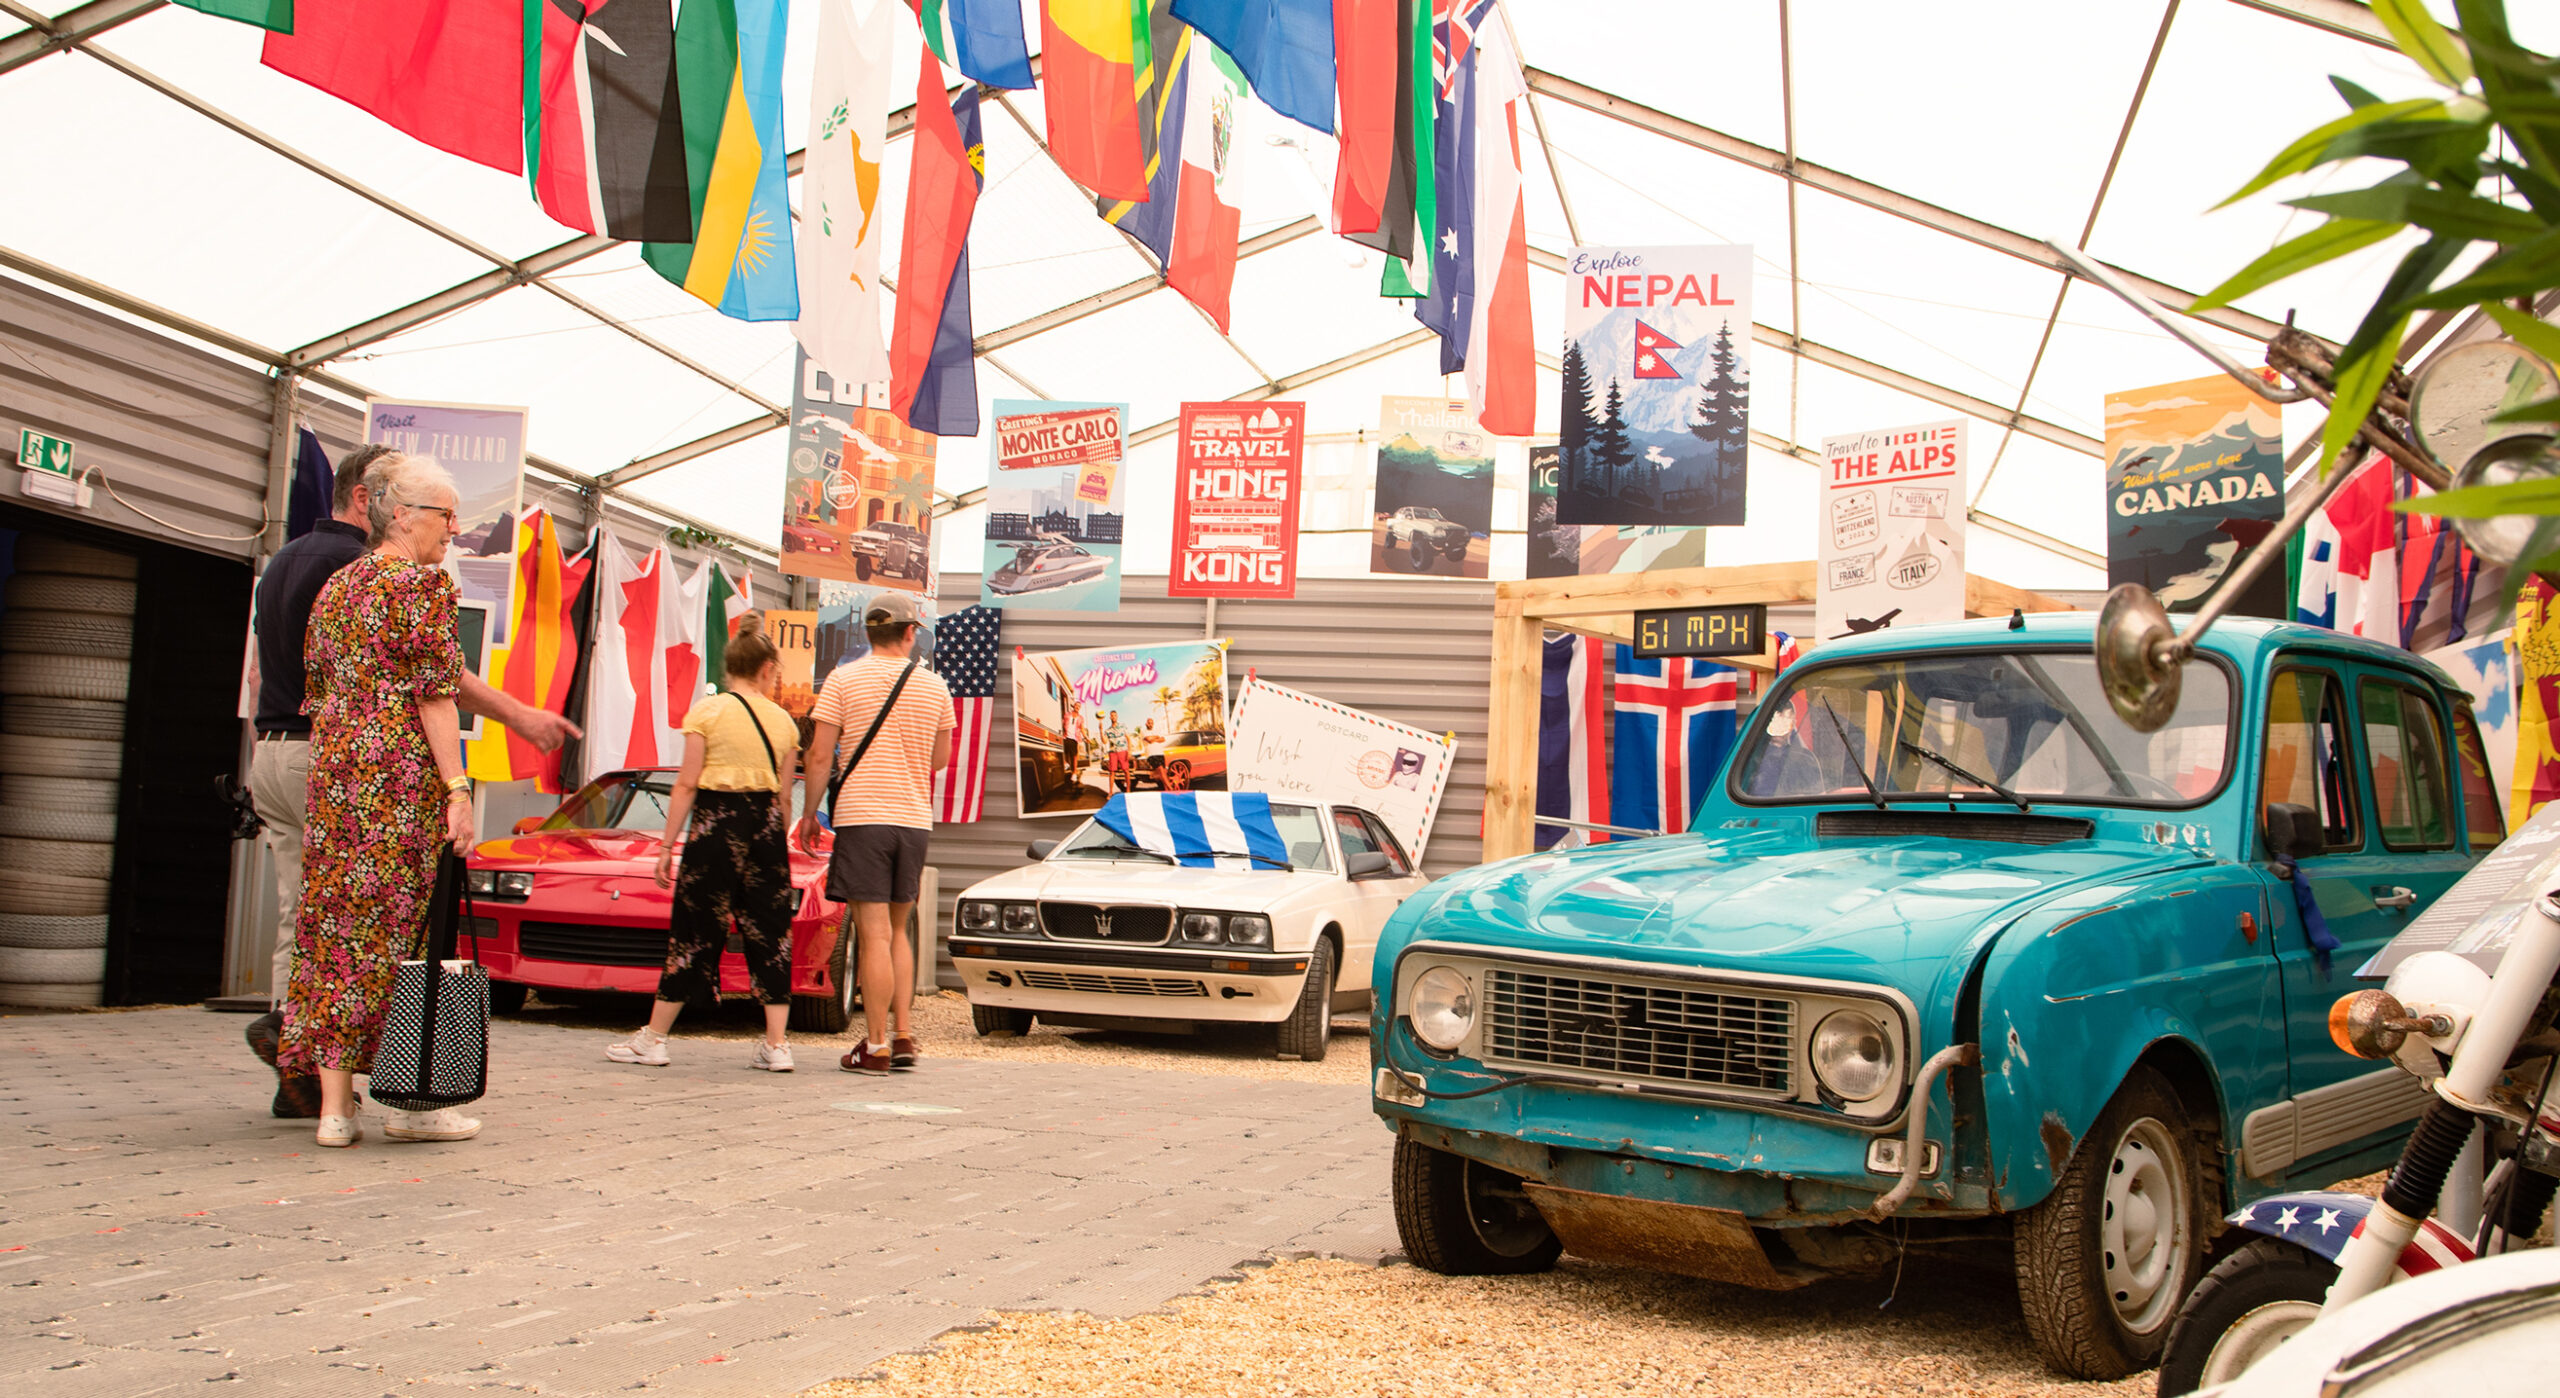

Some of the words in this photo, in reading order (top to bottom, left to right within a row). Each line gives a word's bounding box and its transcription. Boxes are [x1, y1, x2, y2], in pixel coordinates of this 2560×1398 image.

[1572, 251, 1644, 276] Explore
[1583, 273, 1735, 308] NEPAL
[803, 358, 891, 410] CUB
[376, 413, 416, 429] Visit
[1000, 416, 1043, 431] GREETINGS
[432, 433, 507, 463] ZEALAND
[1002, 427, 1060, 457] MONTE
[1062, 417, 1118, 445] CARLO
[1190, 439, 1290, 459] TRAVEL
[1827, 434, 1866, 458] Travel
[1867, 437, 1879, 449] to
[1032, 449, 1078, 464] MONACO
[1831, 454, 1878, 480] THE
[1888, 443, 1956, 473] ALPS
[2122, 470, 2154, 489] Wish
[2158, 468, 2180, 483] you
[2184, 461, 2213, 474] were
[2216, 453, 2243, 466] here
[1188, 469, 1287, 501] HONG
[2115, 472, 2277, 517] CANADA
[1905, 495, 1933, 505] AUSTRIA
[1836, 516, 1876, 535] SWITZERLAND
[1183, 552, 1283, 586] KONG
[1839, 567, 1865, 582] FRANCE
[1900, 562, 1927, 583] ITALY
[1642, 618, 1668, 650] 61
[1686, 614, 1748, 647] MPH
[1075, 657, 1157, 704] Miami
[1317, 720, 1369, 743] POSTCARD
[1256, 730, 1304, 766] Wish
[1234, 772, 1268, 791] you
[851, 1052, 861, 1064] N
